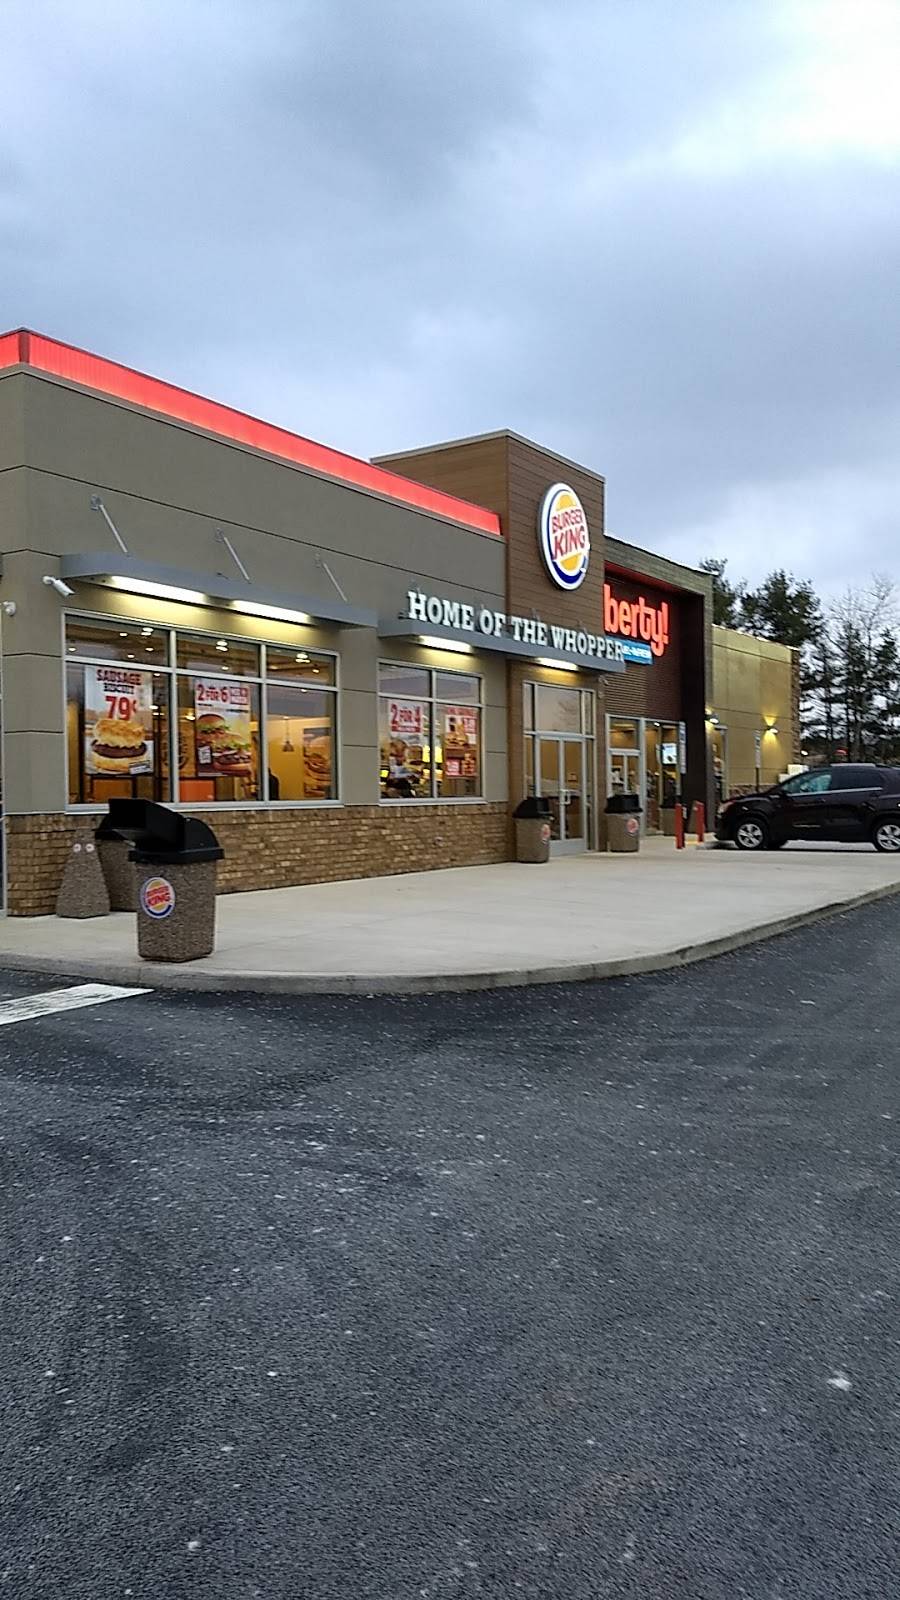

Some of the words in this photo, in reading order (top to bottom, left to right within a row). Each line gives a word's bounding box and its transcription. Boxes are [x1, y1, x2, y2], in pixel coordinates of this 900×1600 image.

[552, 509, 582, 533] BURGER
[553, 525, 585, 560] KING
[407, 591, 474, 631] HOME
[479, 609, 506, 636] OF
[511, 616, 548, 646] THE
[550, 625, 625, 662] WHOPPER
[96, 669, 142, 685] SAUSAGE
[147, 893, 171, 906] KING
